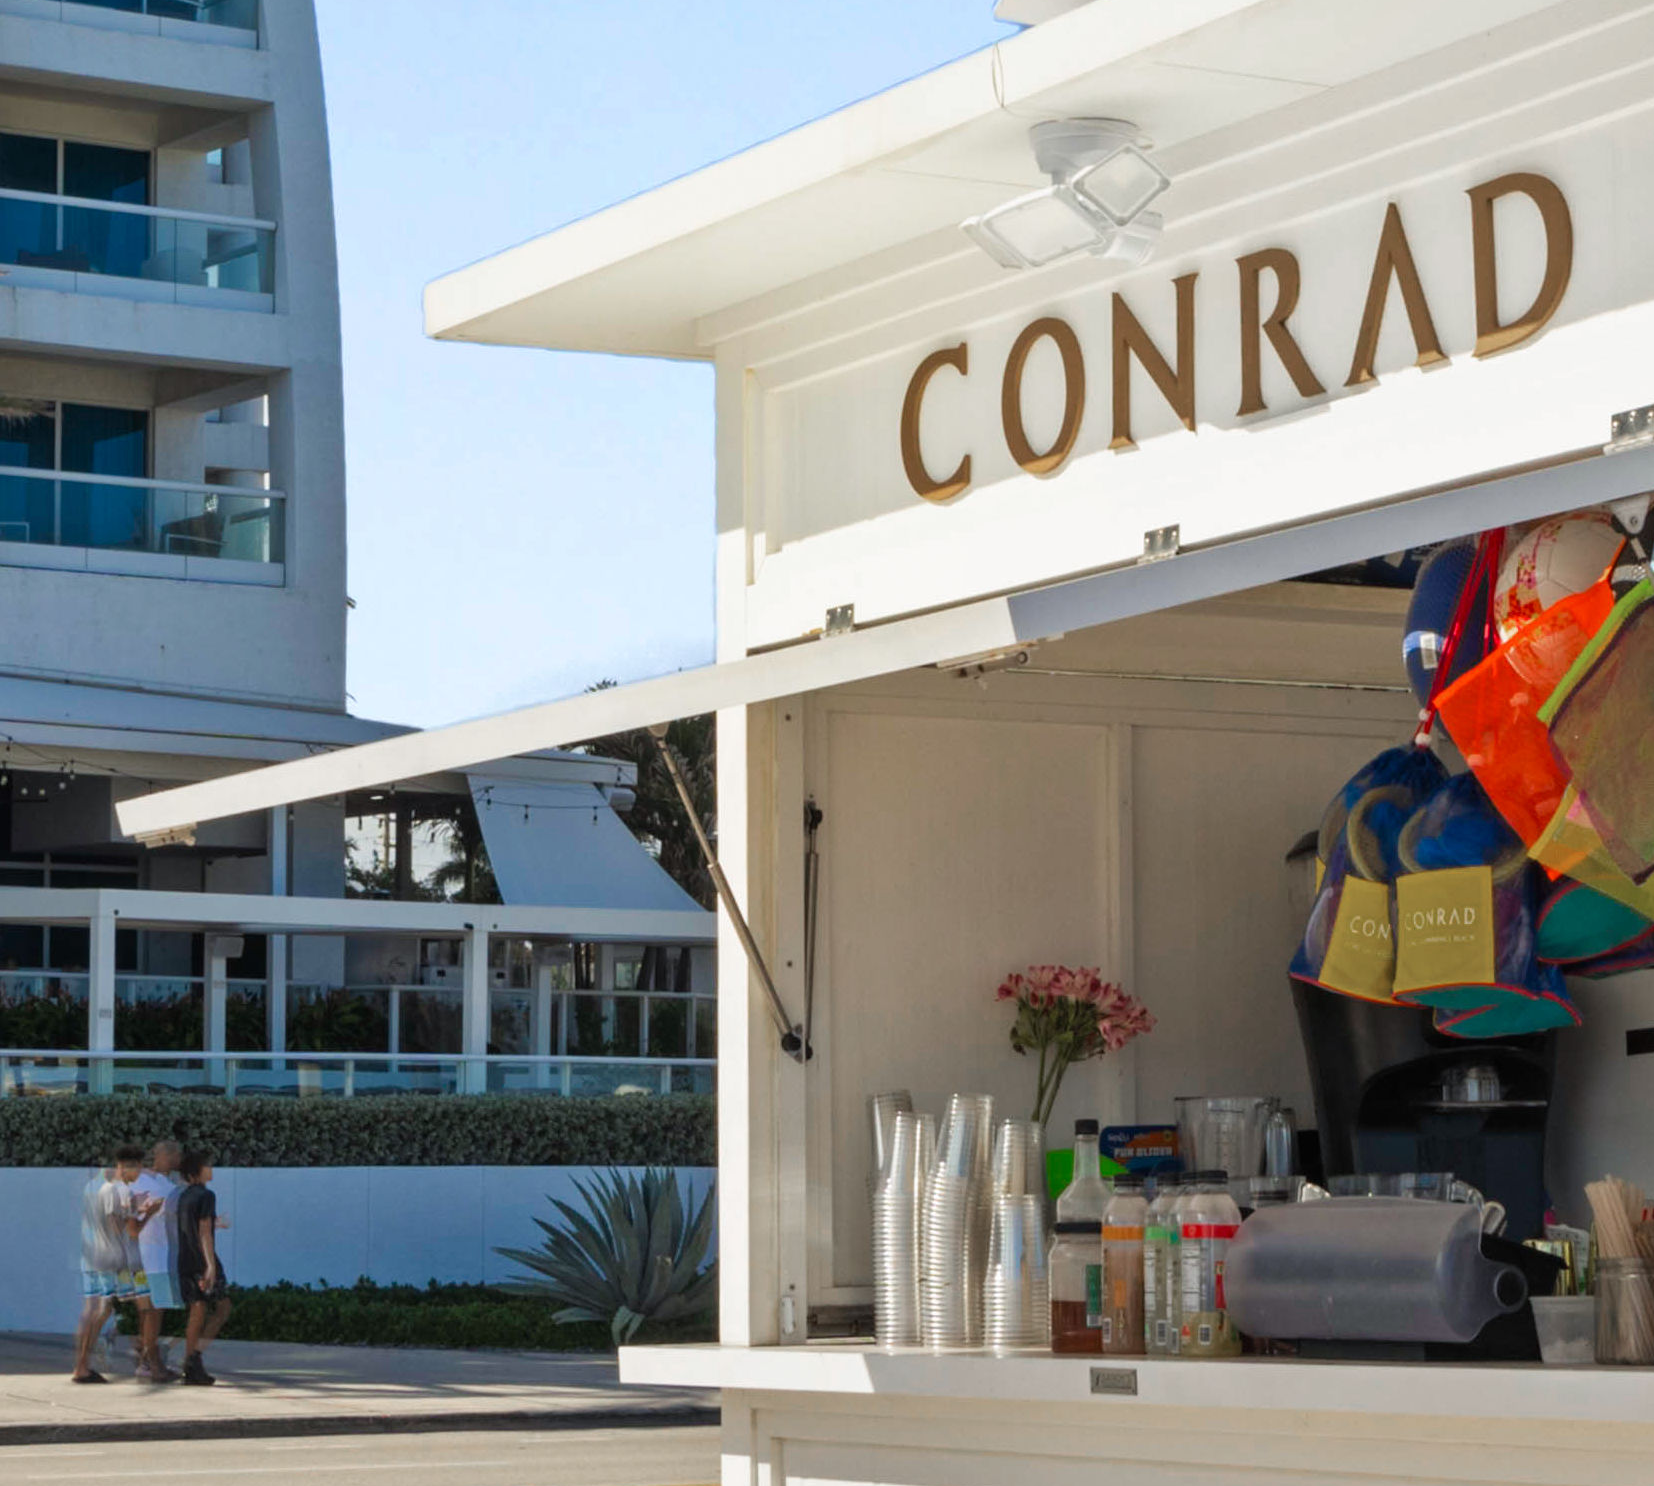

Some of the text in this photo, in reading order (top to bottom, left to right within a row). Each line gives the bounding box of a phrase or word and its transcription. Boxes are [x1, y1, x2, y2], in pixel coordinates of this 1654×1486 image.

[900, 171, 1575, 503] CONRAD
[1350, 915, 1391, 940] CON
[1405, 907, 1476, 931] CONRAD
